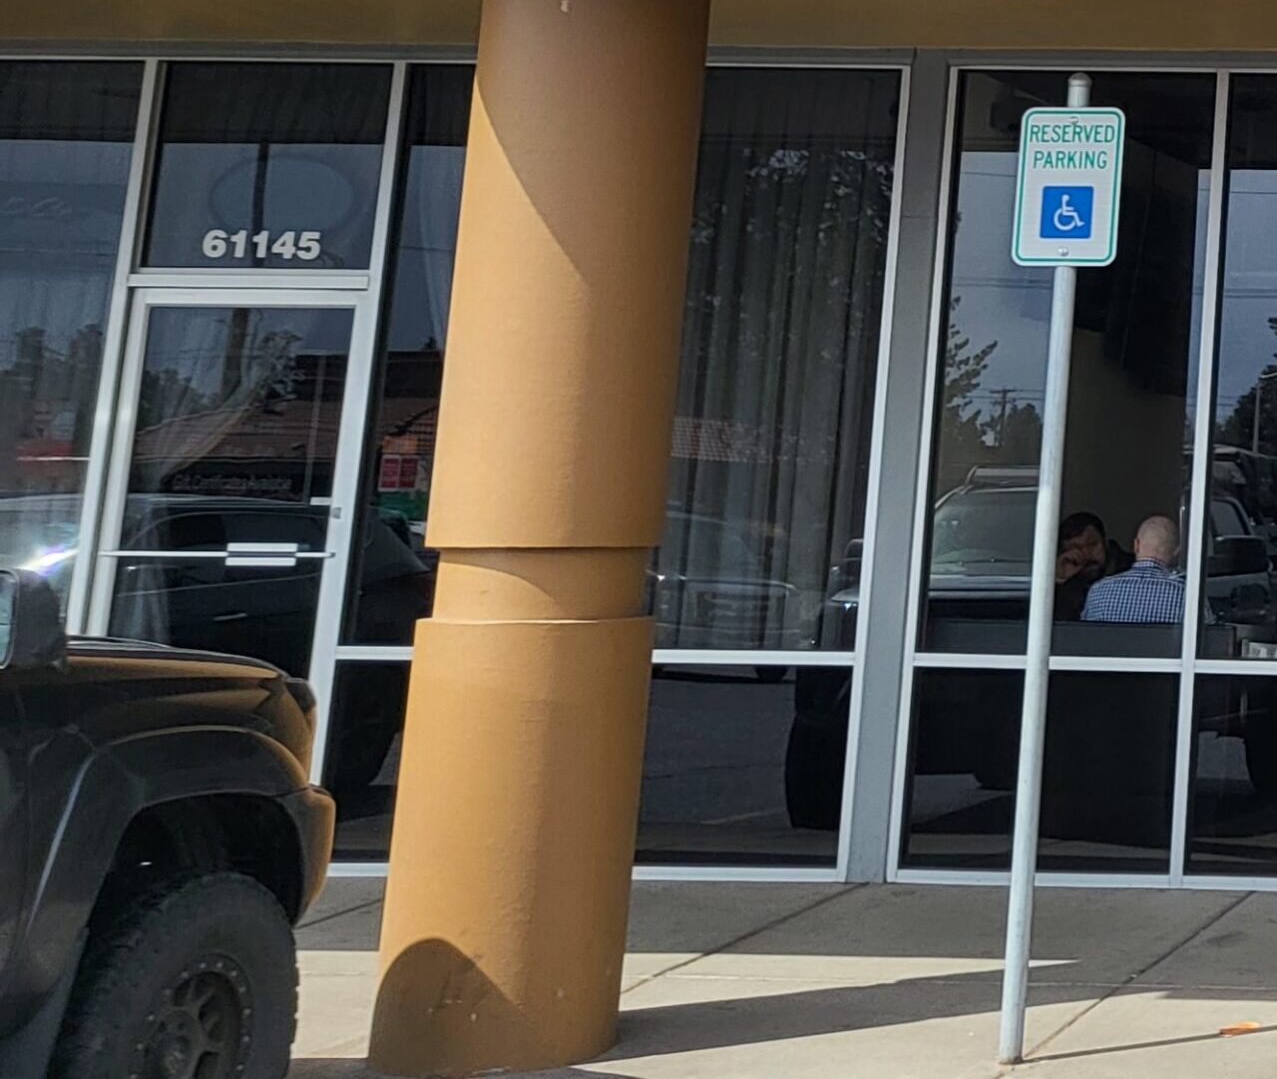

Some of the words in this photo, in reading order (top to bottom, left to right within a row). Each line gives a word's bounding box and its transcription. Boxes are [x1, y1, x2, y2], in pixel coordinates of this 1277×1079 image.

[1030, 125, 1115, 143] RESERVED
[1033, 151, 1107, 169] PARKING
[202, 229, 322, 260] 61145
